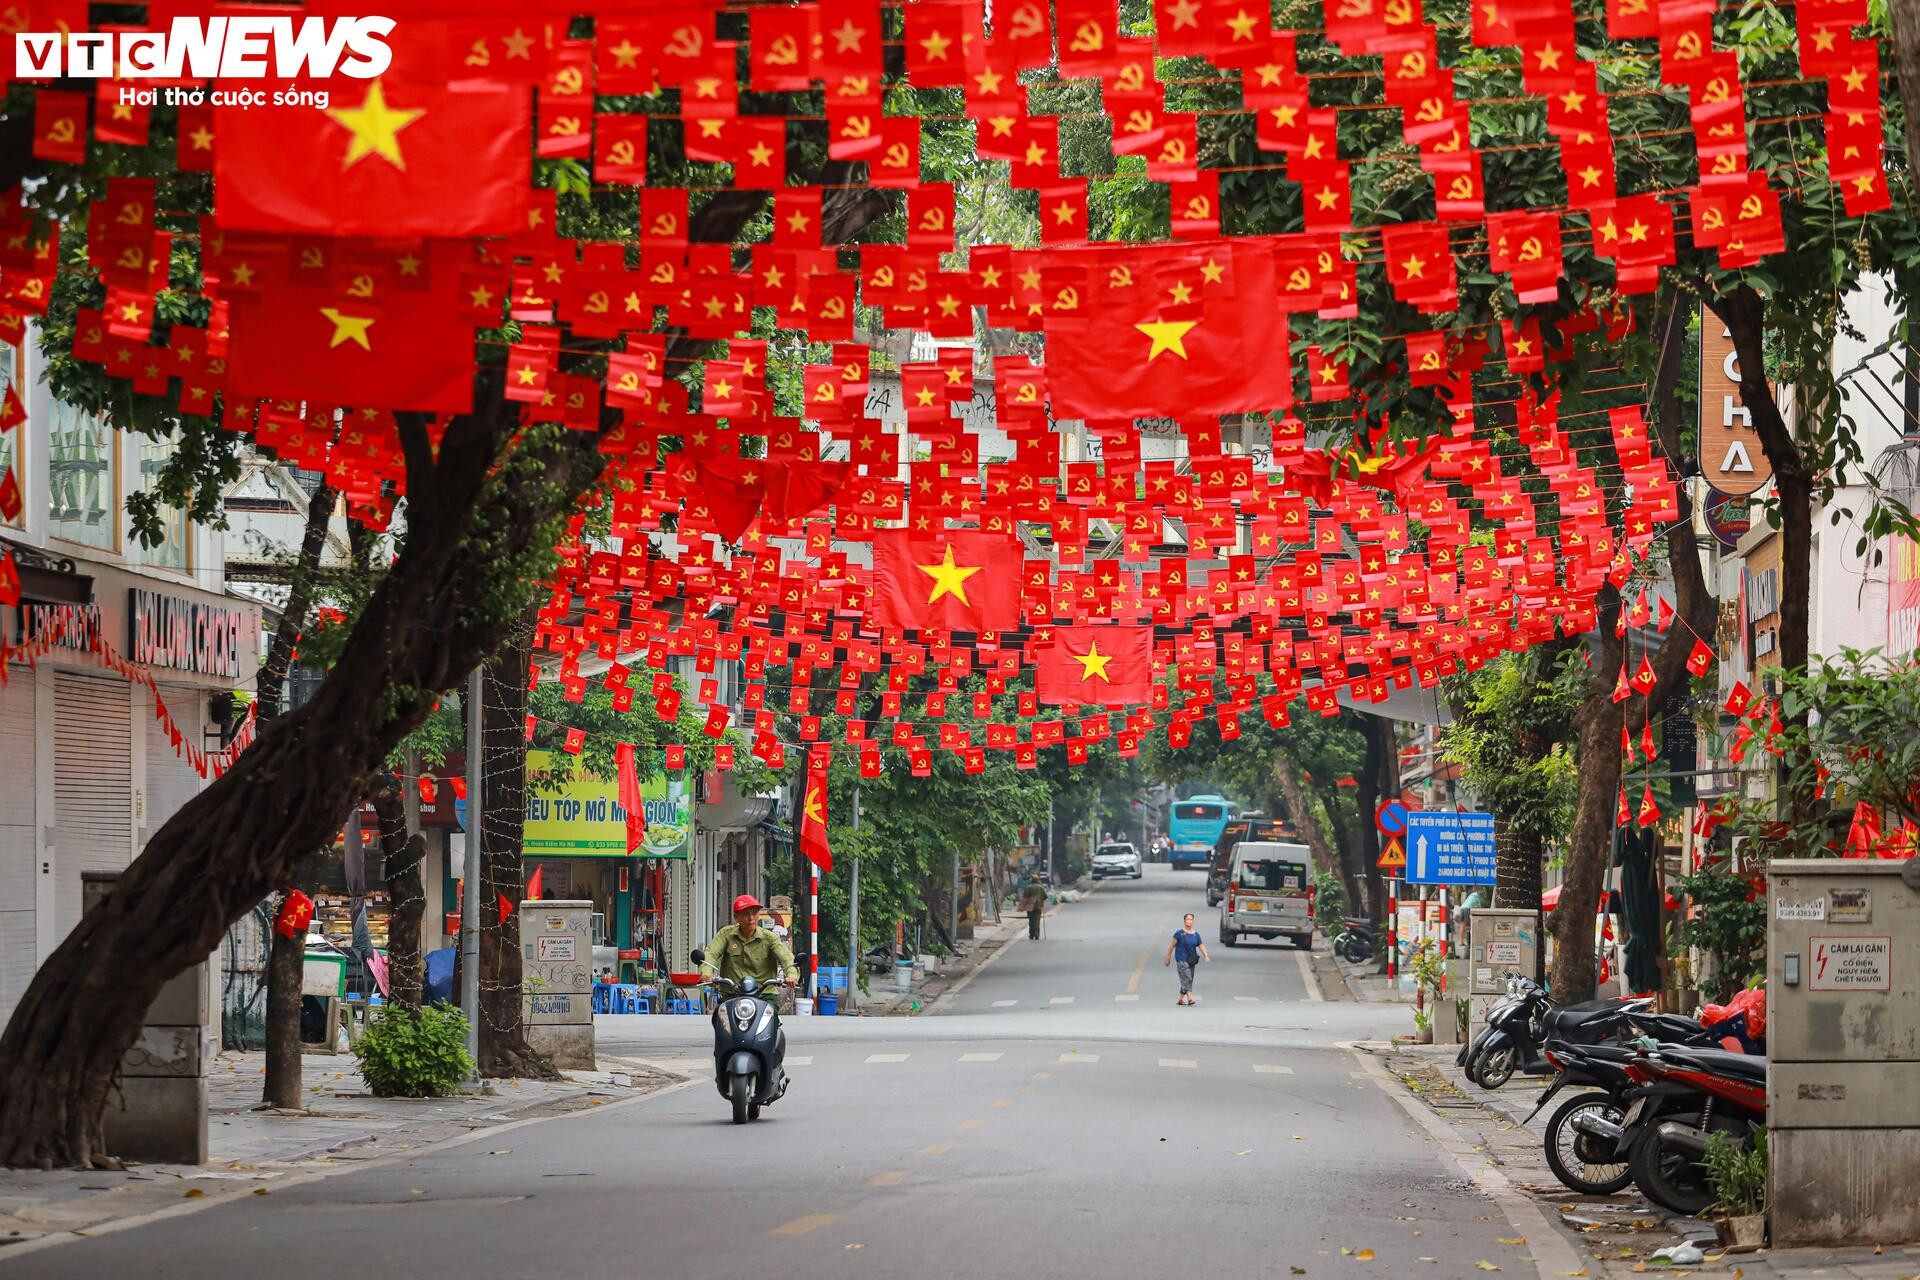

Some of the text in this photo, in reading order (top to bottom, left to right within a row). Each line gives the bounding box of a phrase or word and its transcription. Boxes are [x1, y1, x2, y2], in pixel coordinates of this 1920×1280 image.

[554, 792, 580, 822] TÓP
[645, 793, 676, 823] GIÒN
[1850, 944, 1863, 956] LẠI
